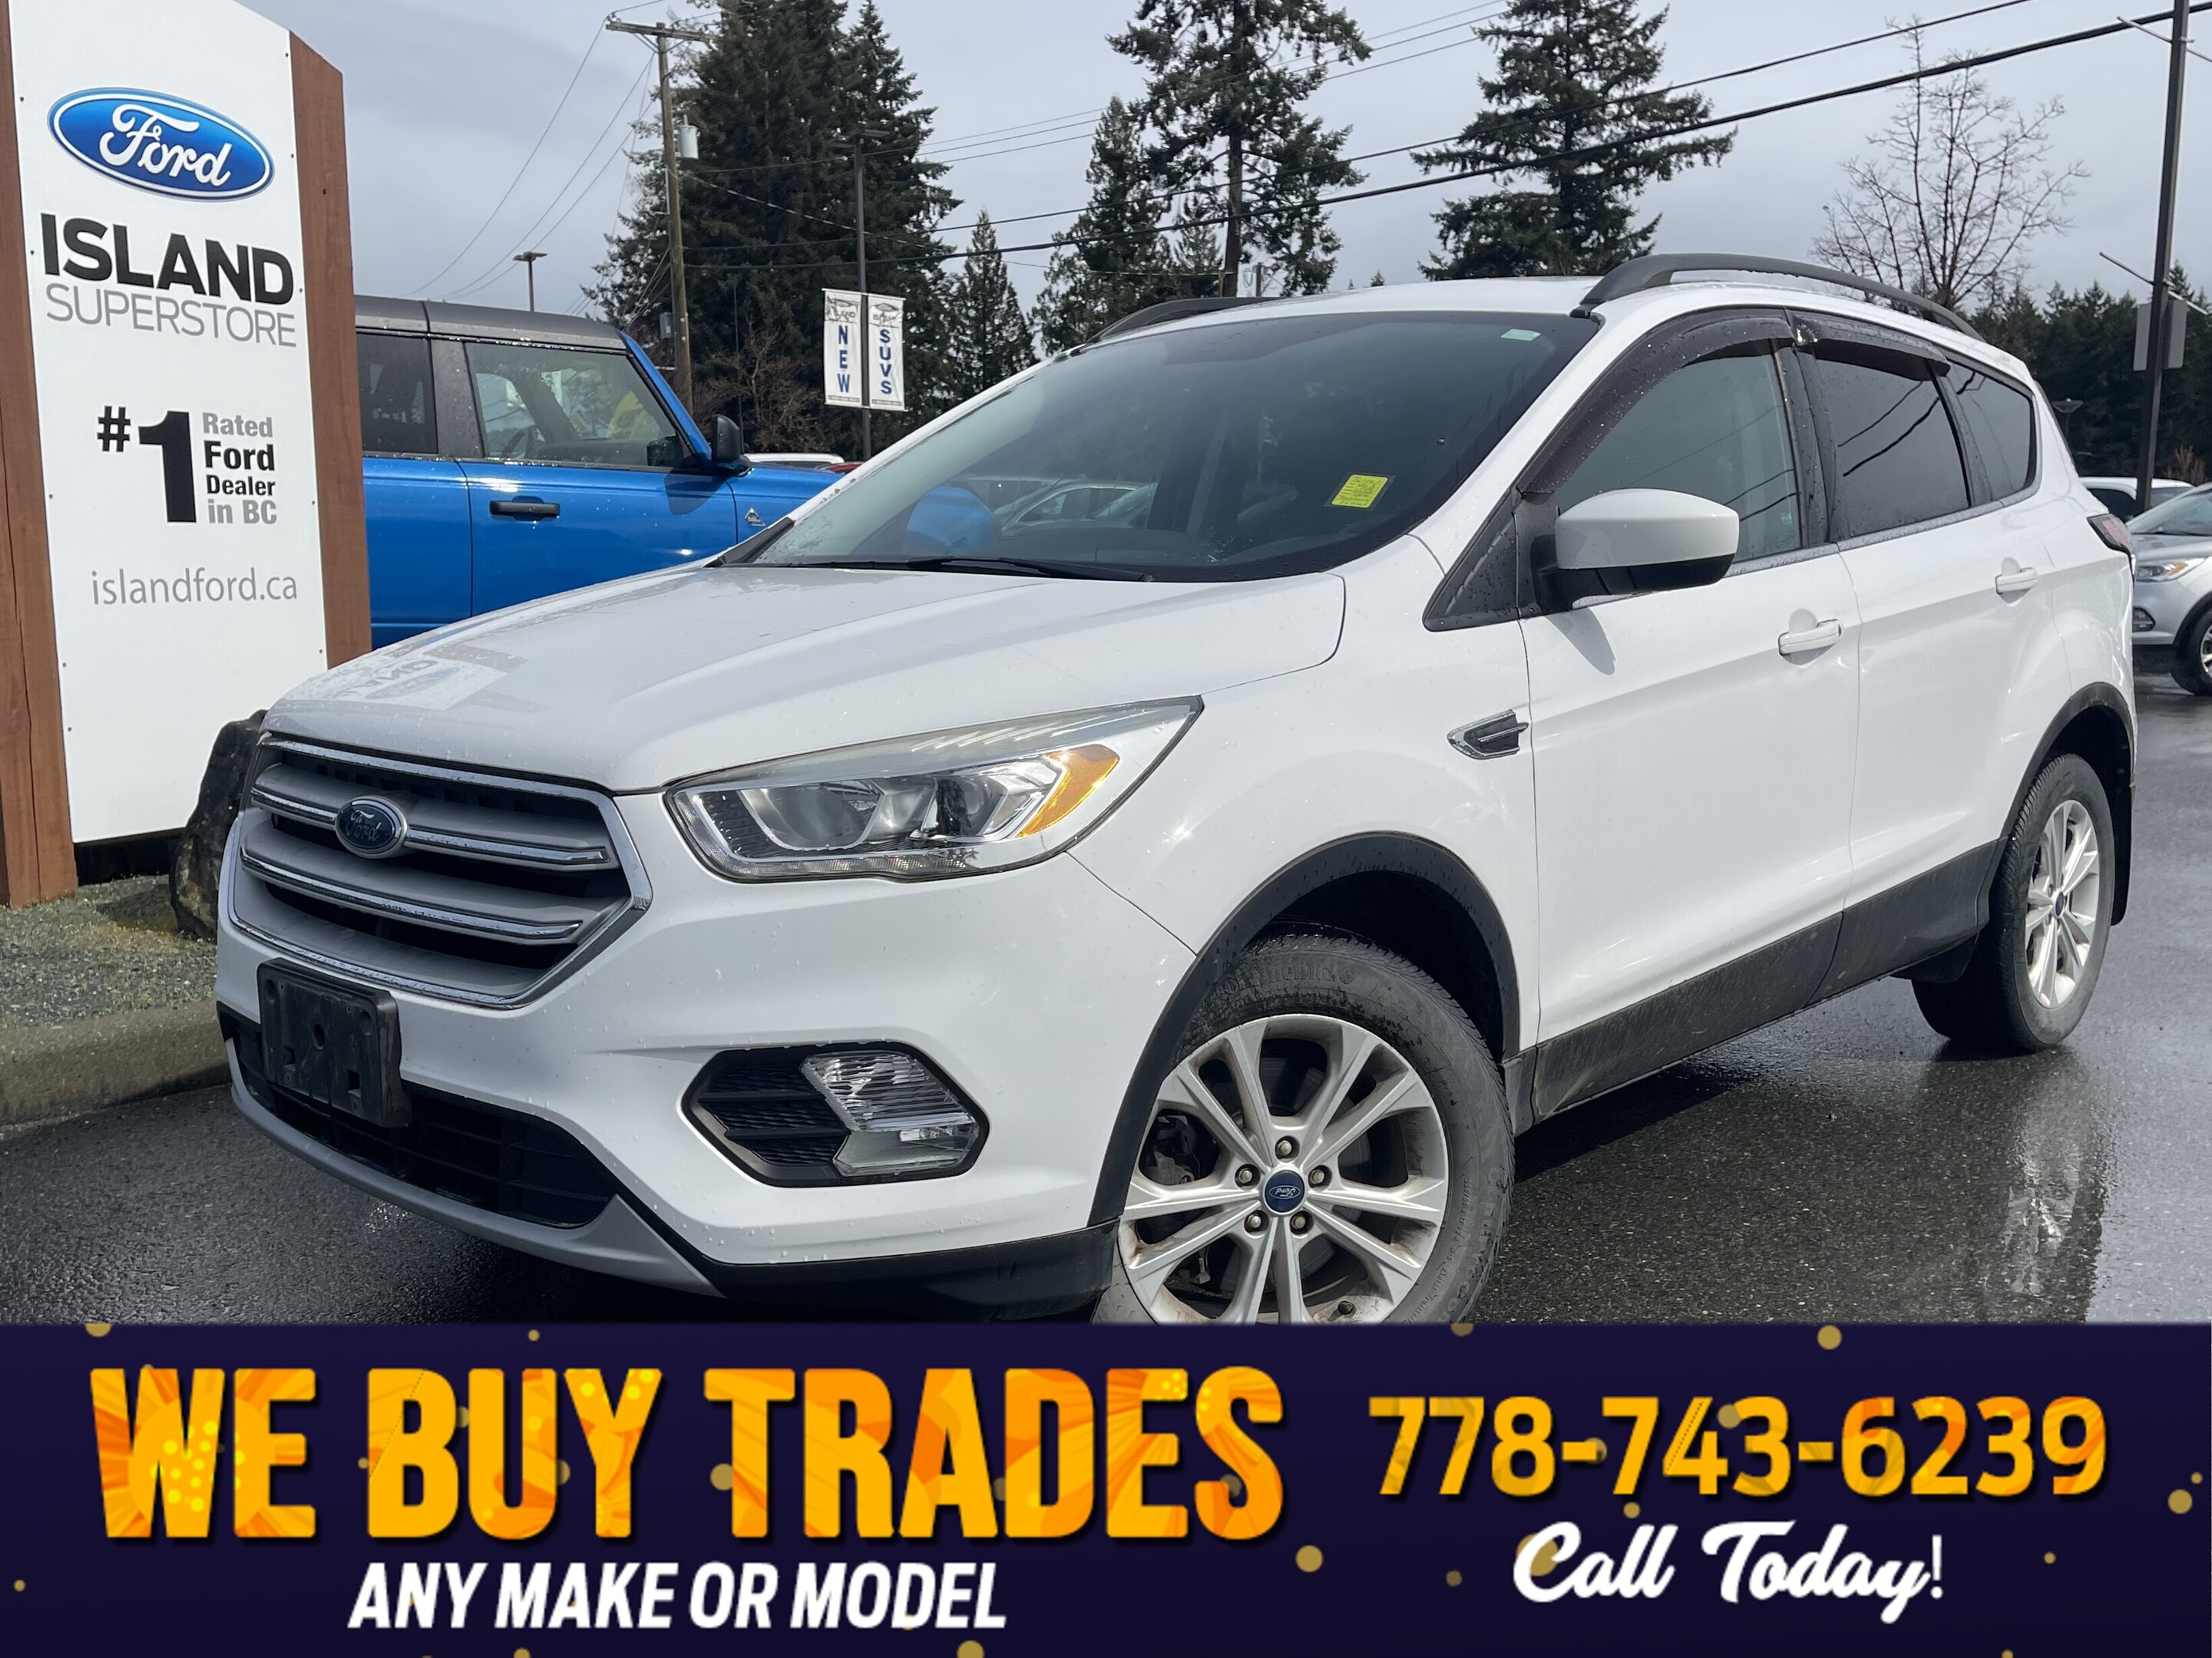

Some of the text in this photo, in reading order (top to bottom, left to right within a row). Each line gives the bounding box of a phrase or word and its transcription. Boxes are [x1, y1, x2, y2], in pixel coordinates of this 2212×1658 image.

[99, 104, 232, 187] Ford
[41, 213, 294, 306] ISLAND
[46, 282, 297, 347] SUPERSTORE
[837, 325, 851, 393] NEW
[879, 329, 892, 395] SUVS
[203, 412, 273, 438] Rated
[203, 440, 275, 471] Ford
[206, 474, 276, 496] Dealer
[207, 499, 277, 524] in BC
[91, 567, 297, 605] islandford.ca
[346, 810, 382, 841] Ford
[1275, 1187, 1296, 1197] Ford
